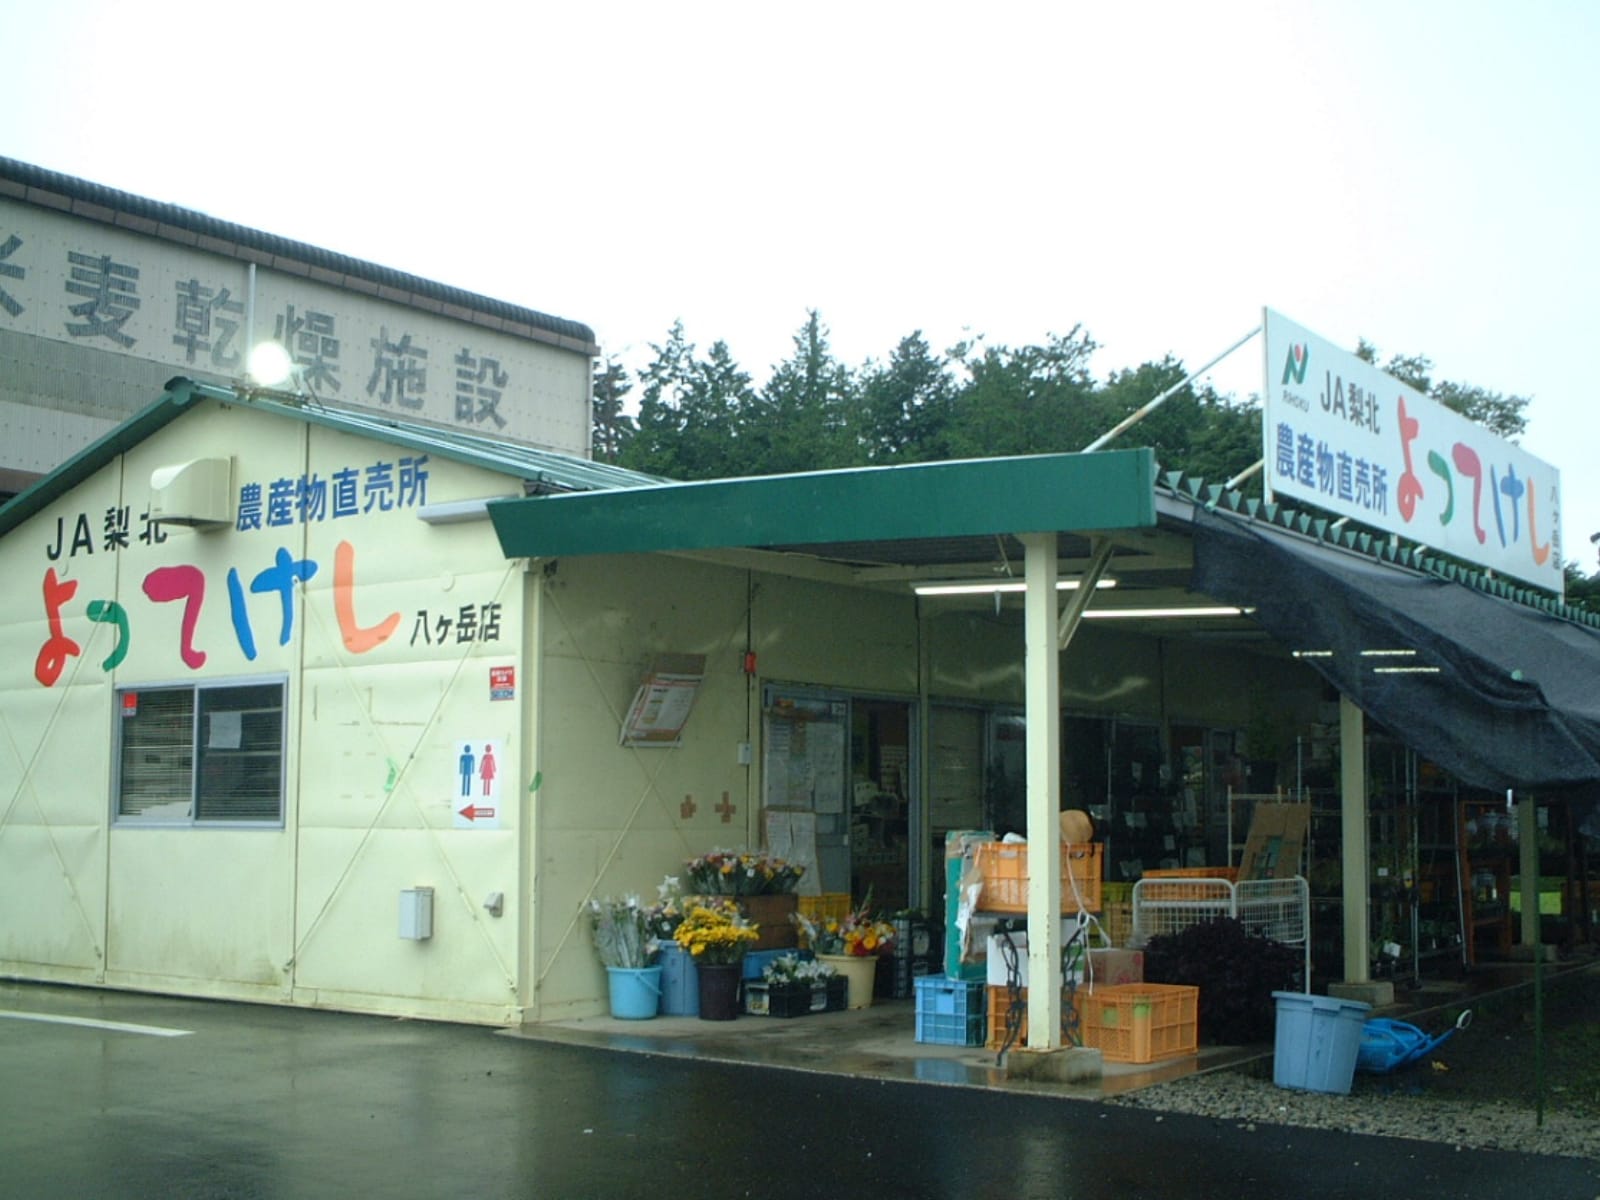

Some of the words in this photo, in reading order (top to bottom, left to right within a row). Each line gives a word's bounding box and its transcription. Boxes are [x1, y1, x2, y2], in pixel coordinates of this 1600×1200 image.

[1320, 370, 1380, 434] JA梨北
[236, 455, 429, 531] 農産物直売所
[1276, 422, 1388, 516] 農産物直売所
[1397, 395, 1549, 566] よってけし
[47, 504, 168, 560] JA梨北
[35, 540, 400, 687] よってけし
